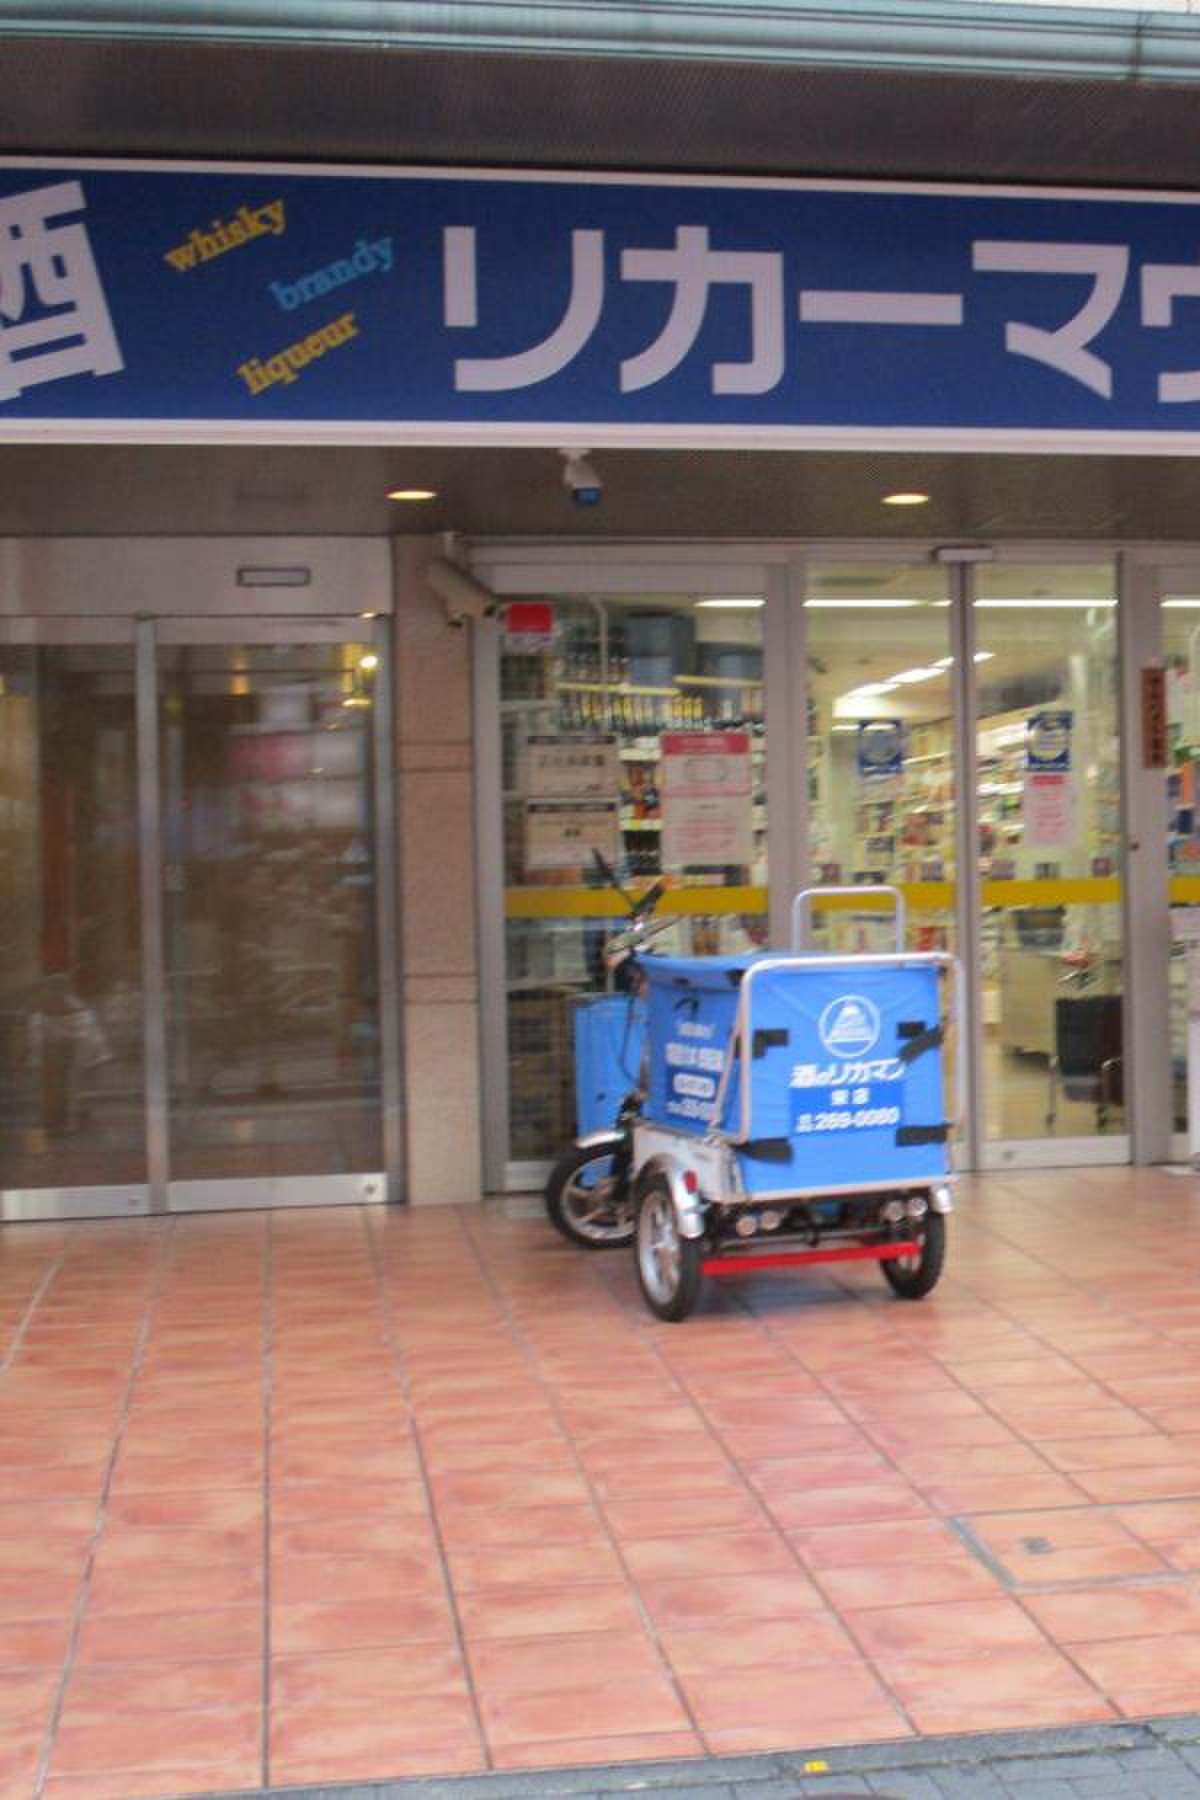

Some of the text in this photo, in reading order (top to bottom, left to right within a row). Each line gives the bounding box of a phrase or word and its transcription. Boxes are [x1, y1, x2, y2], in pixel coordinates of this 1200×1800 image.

[163, 199, 286, 273] whisky
[267, 236, 393, 312] brandy
[235, 312, 360, 396] liqueur
